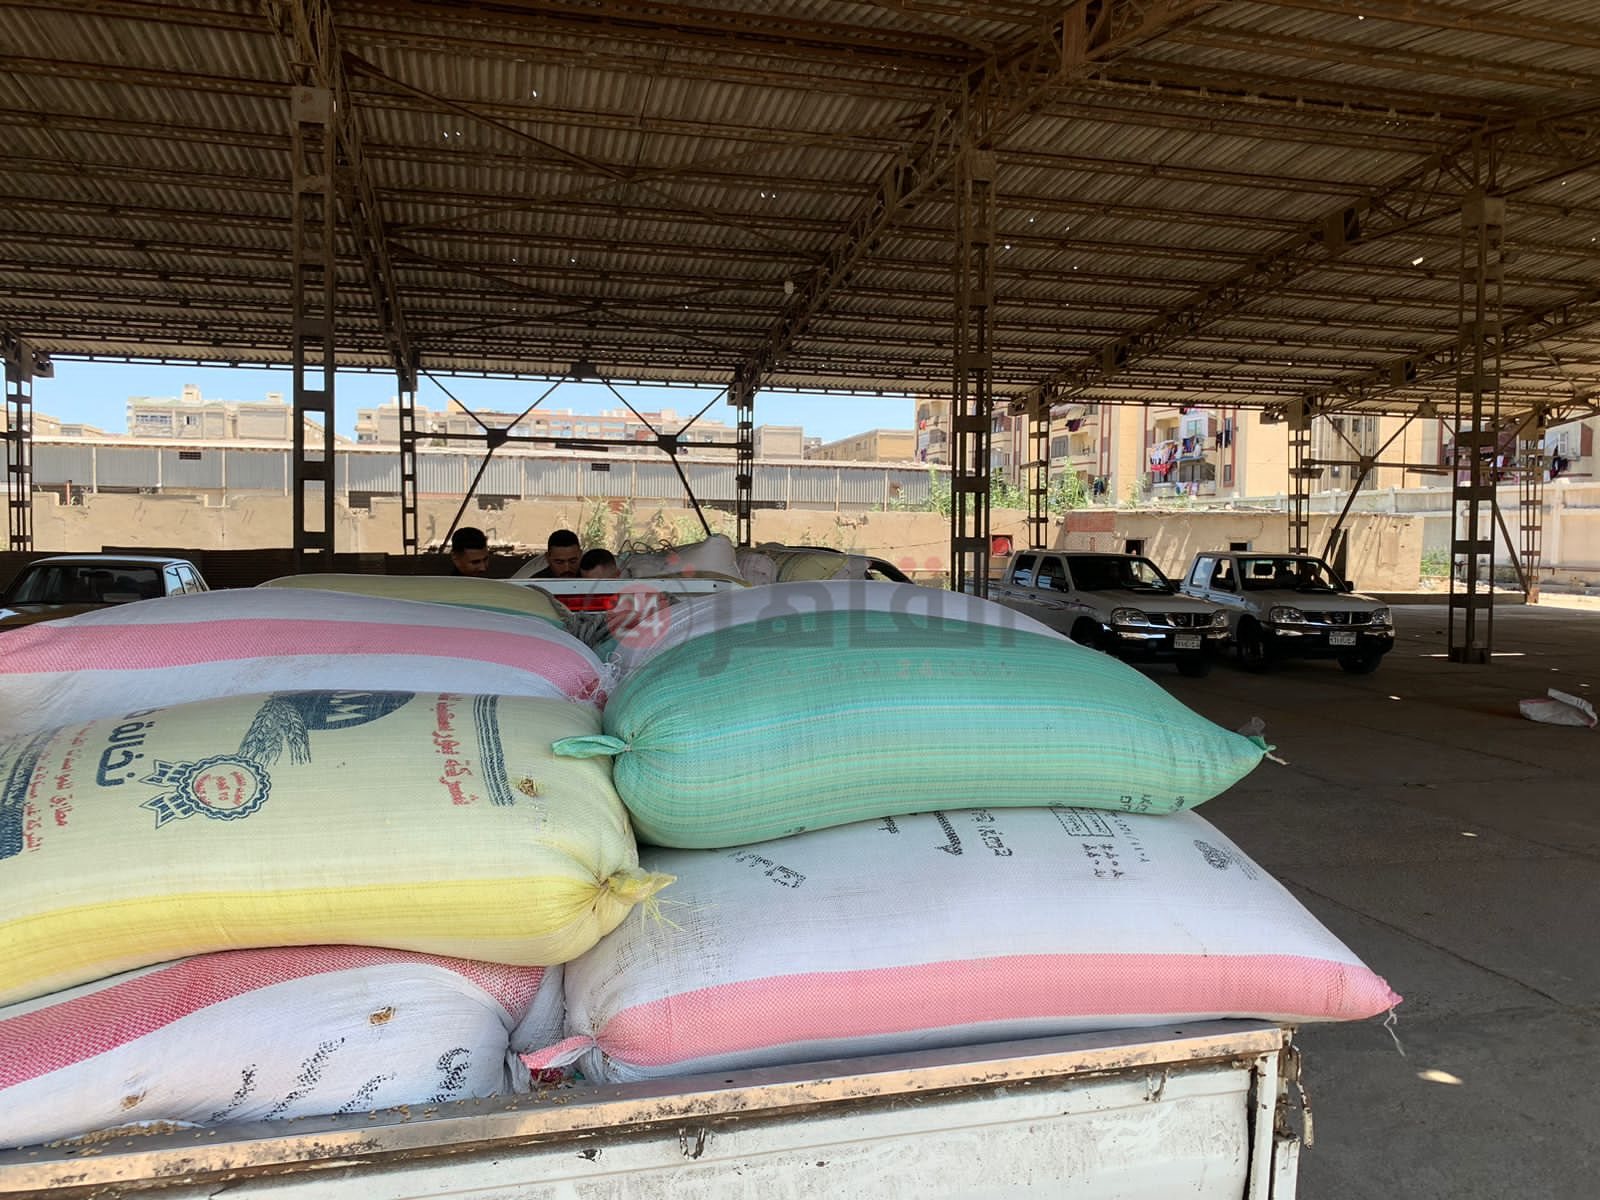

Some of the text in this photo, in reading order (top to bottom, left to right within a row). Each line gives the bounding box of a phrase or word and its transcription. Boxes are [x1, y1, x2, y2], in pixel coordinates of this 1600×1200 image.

[96, 721, 156, 787] نخالة
[439, 758, 479, 806] شركة
[50, 793, 74, 826] مطابق
